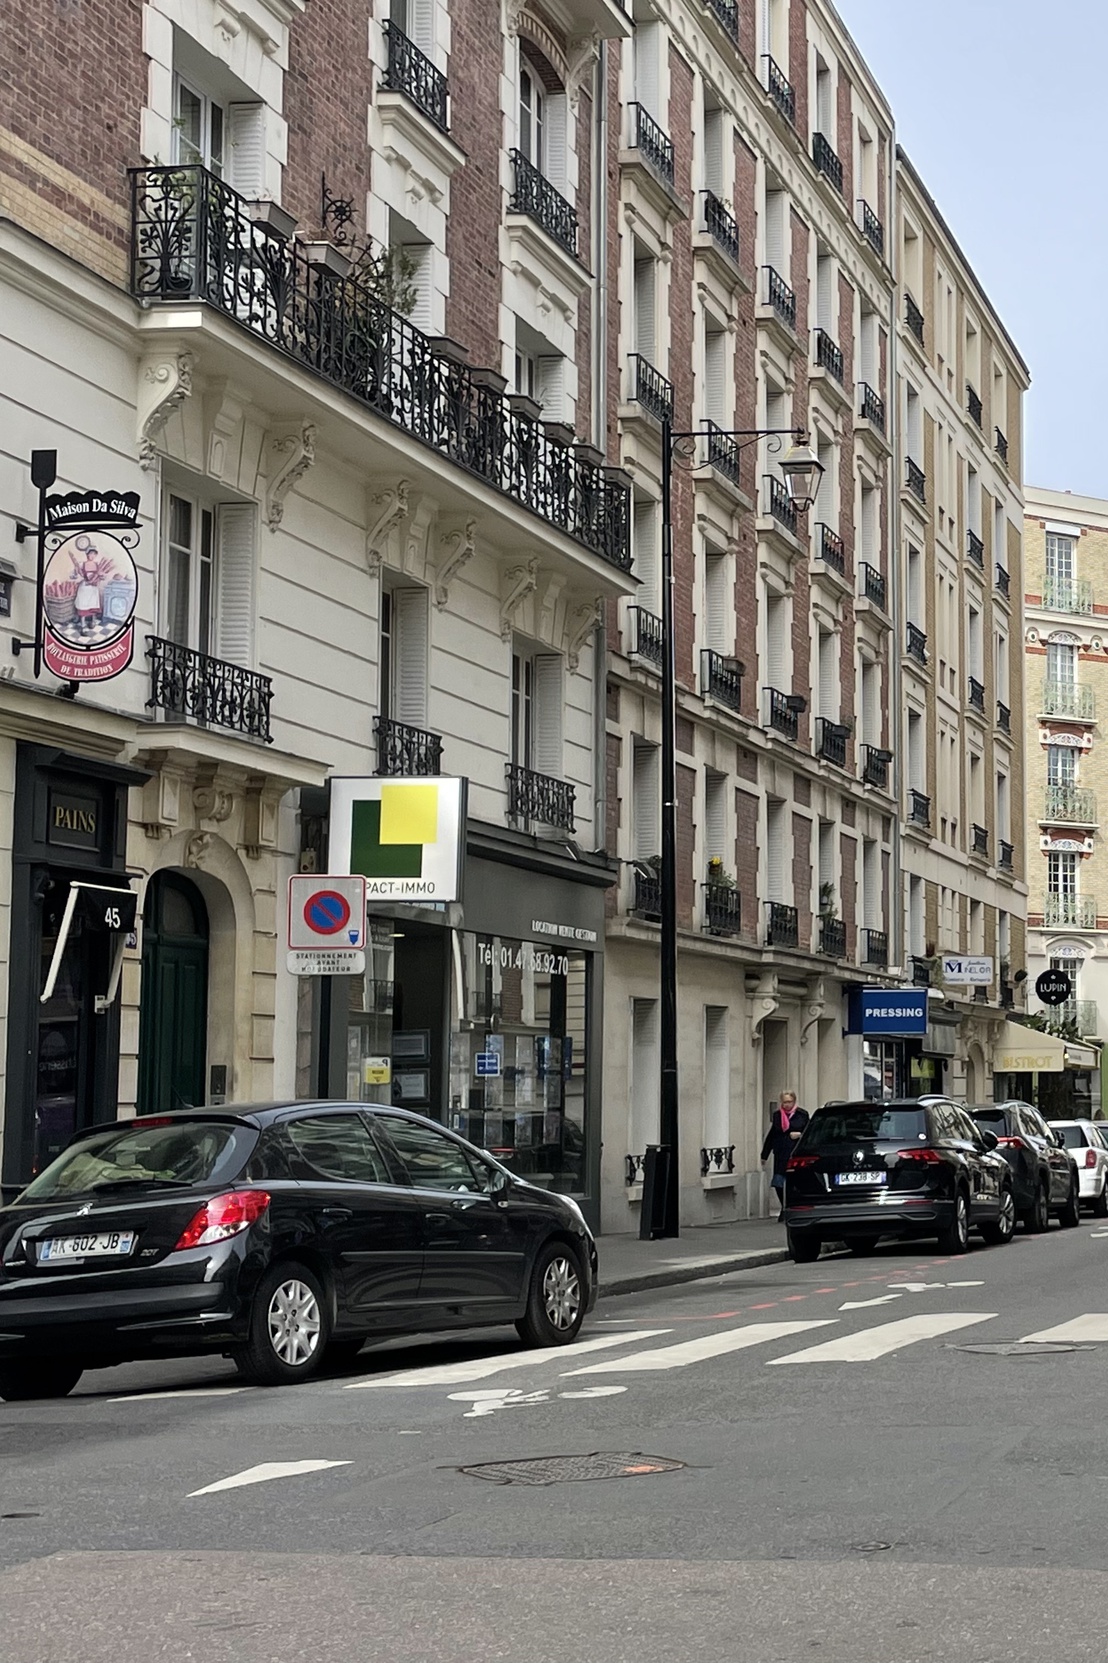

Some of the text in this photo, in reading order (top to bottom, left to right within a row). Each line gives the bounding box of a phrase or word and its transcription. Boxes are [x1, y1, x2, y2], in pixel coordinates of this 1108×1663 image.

[48, 498, 136, 521] Maison Da Silva
[47, 642, 88, 665] BOULANGERIE
[60, 663, 113, 676] DE TRADITION
[54, 805, 96, 834] PAINS
[104, 907, 121, 929] 45
[531, 919, 558, 935] LOCATION
[558, 925, 575, 939] VENTE
[1040, 983, 1067, 992] LUPIN
[865, 1008, 924, 1017] PRESSING
[1003, 1055, 1054, 1068] BISTROT
